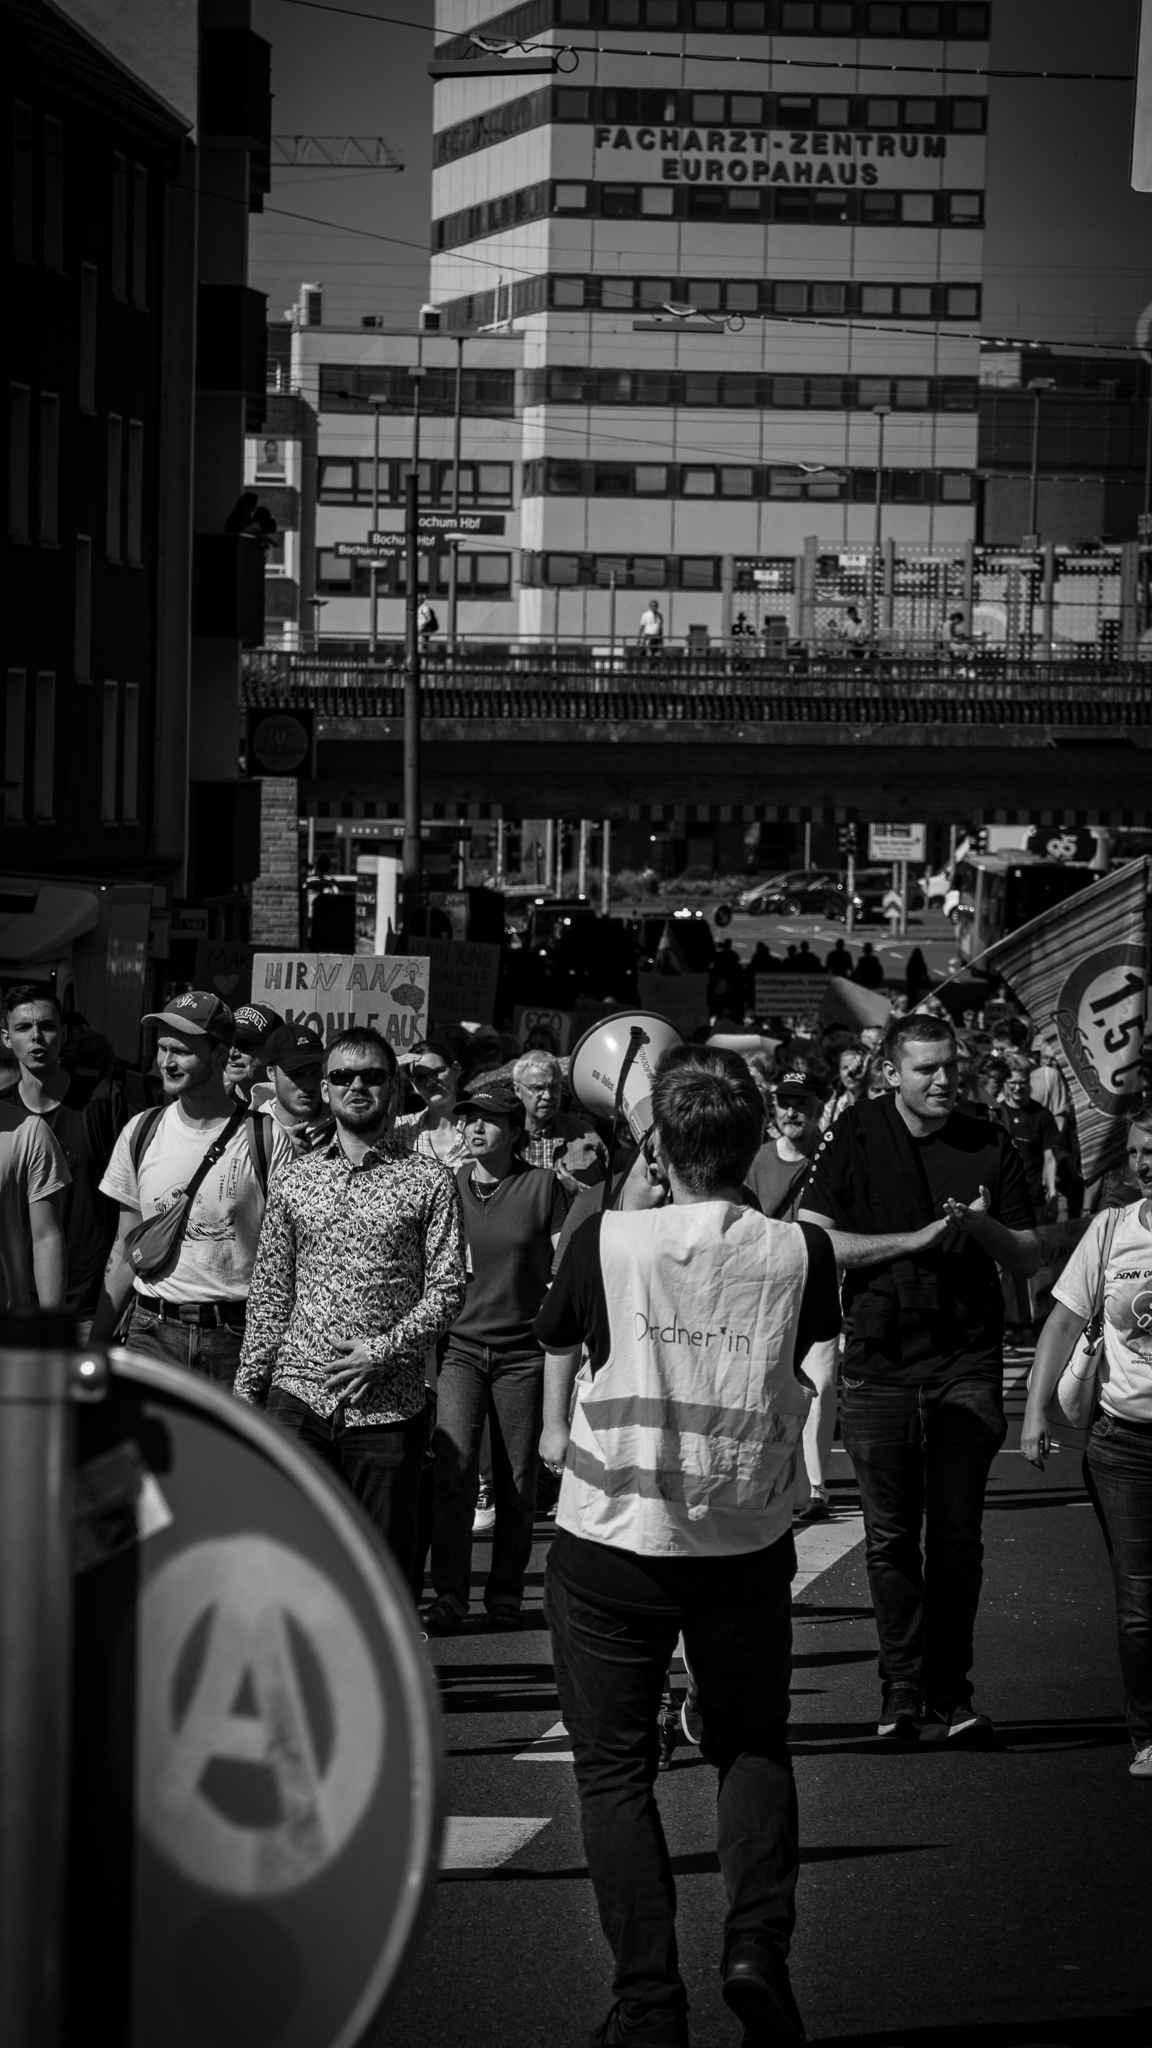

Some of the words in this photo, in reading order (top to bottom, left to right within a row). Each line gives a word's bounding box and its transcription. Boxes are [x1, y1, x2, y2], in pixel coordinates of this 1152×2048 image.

[662, 158, 880, 186] EUROPAHAUS
[417, 516, 458, 529] ochum
[459, 517, 482, 530] Hbf
[372, 533, 406, 546] Bochu
[417, 535, 437, 547] Hbf
[207, 949, 254, 971] MAK
[453, 945, 494, 968] JUNG
[265, 961, 343, 992] HIRN
[346, 963, 404, 993] AN
[435, 990, 486, 1012] WELT
[386, 1013, 425, 1048] AUS
[1113, 1269, 1141, 1280] DENN
